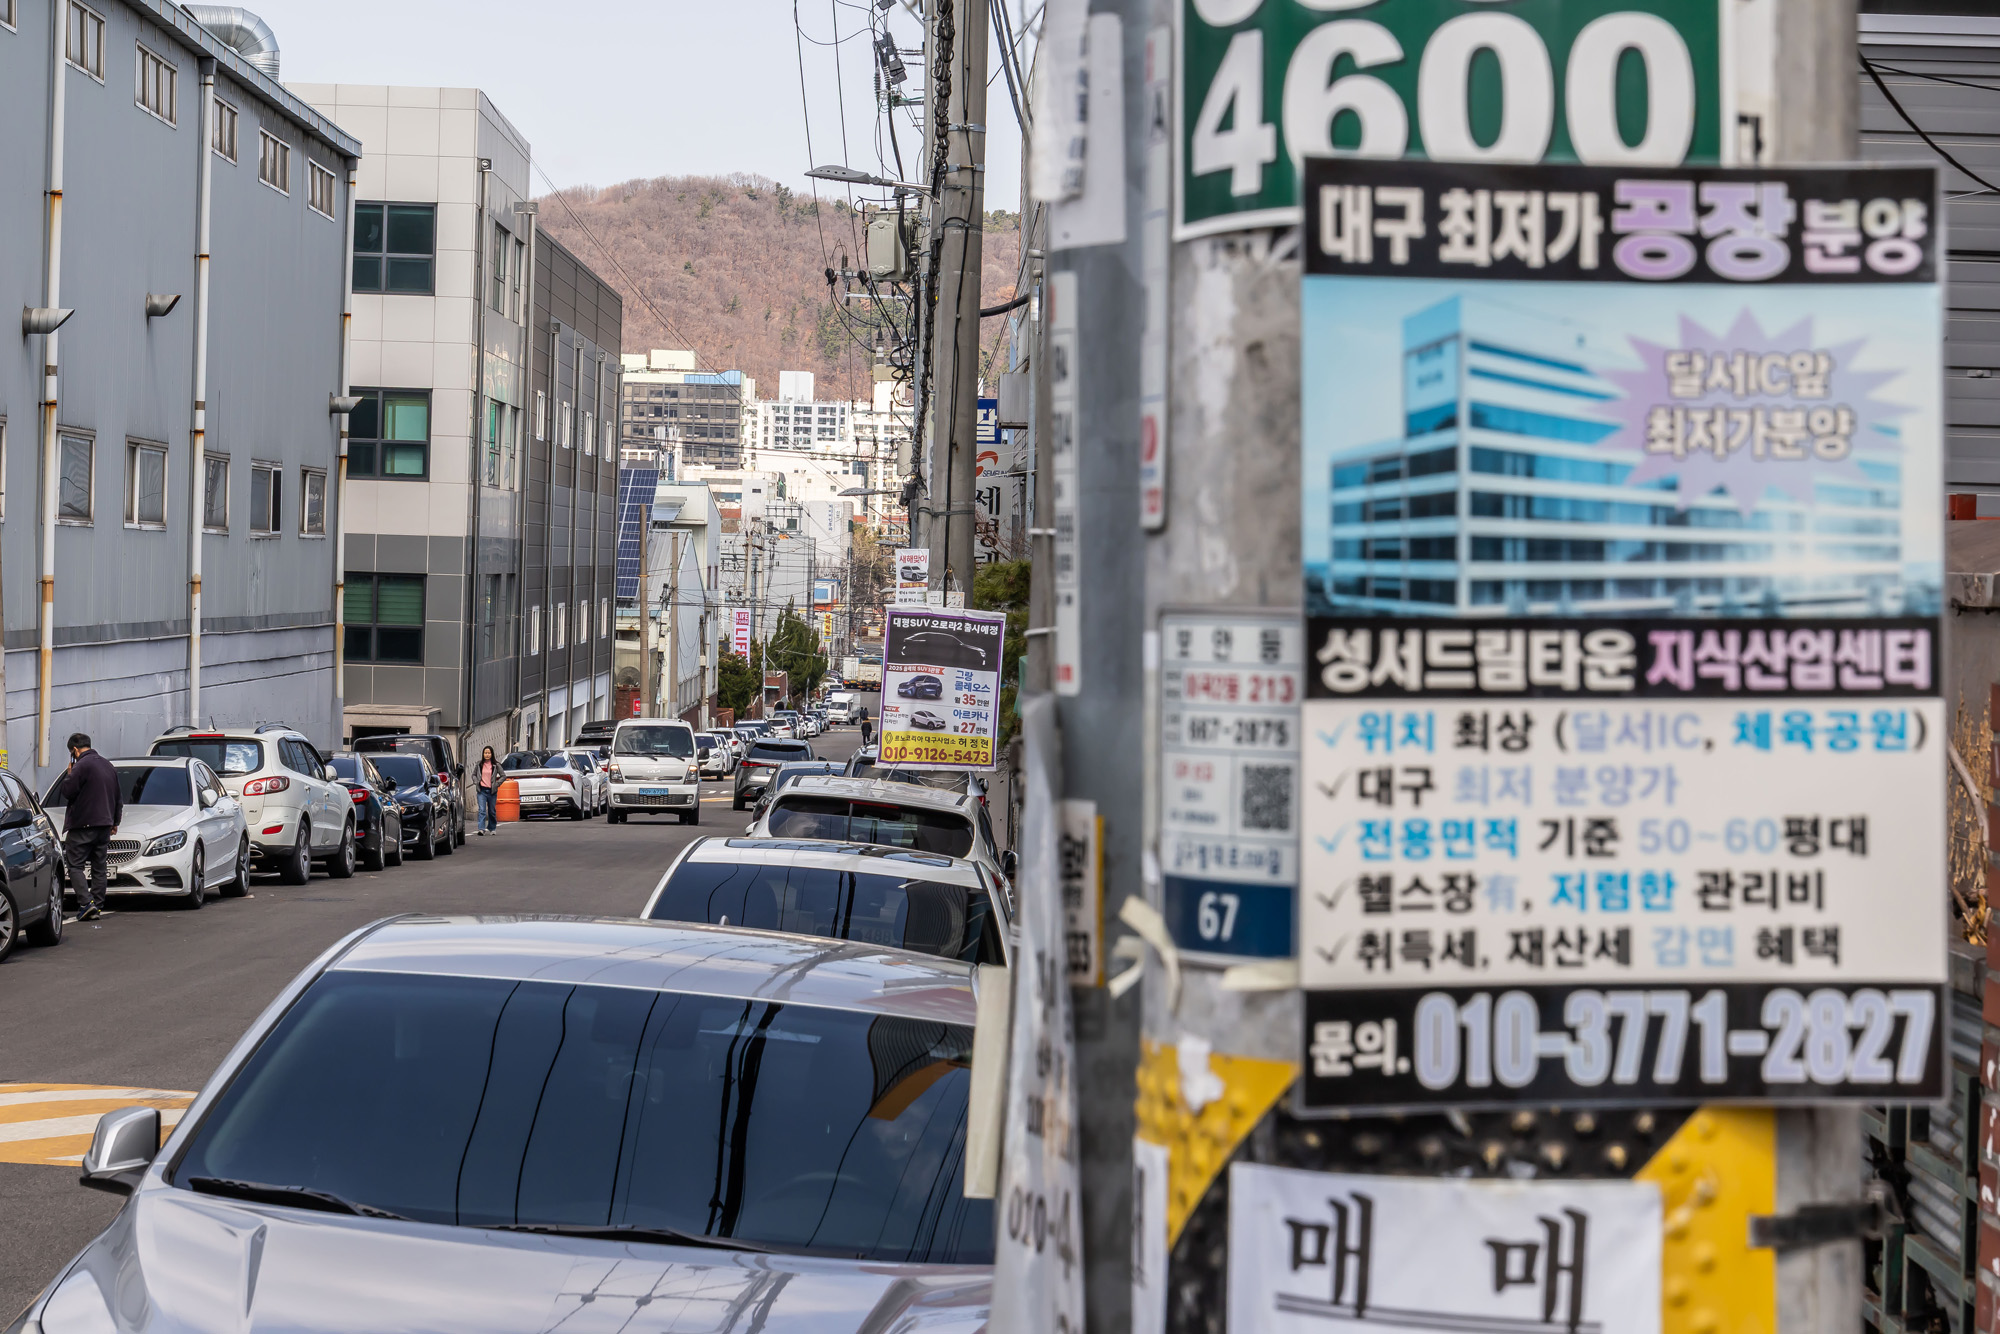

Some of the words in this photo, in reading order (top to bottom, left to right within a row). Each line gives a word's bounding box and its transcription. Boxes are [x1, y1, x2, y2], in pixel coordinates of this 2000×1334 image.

[1319, 184, 1426, 264] 대구
[1440, 189, 1604, 270] 최저가
[1611, 179, 1795, 281] 공장
[1803, 198, 1928, 276] 분양
[1665, 348, 1835, 400] 달서IC앞
[1645, 404, 1857, 461] 최저가분양
[899, 554, 928, 564] 새해맞이
[893, 618, 930, 629] 대형SUV
[931, 620, 963, 632] 오로라2
[963, 622, 999, 636] 출시예정
[955, 669, 974, 681] 그랑
[1316, 628, 1639, 693] 성서드림타운
[1646, 628, 1932, 691] 지식산업센터
[954, 680, 991, 693] 콜레오스
[962, 693, 977, 706] 35
[976, 698, 990, 707] 만원
[952, 708, 989, 721] 아르카나
[960, 722, 976, 734] 27
[975, 726, 988, 735] 만원
[1355, 711, 1437, 754] 위치
[1453, 711, 1536, 753] 최상
[1732, 710, 1929, 754] 체육공원)
[883, 746, 989, 763] 010-9126-5473
[894, 734, 924, 743] 르노코리아
[924, 736, 957, 745] 대구사업소
[1357, 765, 1436, 807] 대구
[1453, 765, 1535, 806] 최저
[1551, 764, 1681, 805] 분양가
[1356, 818, 1520, 861] 전용면적
[1538, 818, 1621, 858] 기준
[1550, 871, 1679, 914] 저렴한
[1695, 870, 1826, 914] 관리비
[1198, 890, 1241, 942] 67
[1356, 928, 1491, 972] 취득세,
[1507, 926, 1634, 969] 재산세
[1651, 925, 1736, 969] 감면
[1754, 925, 1843, 968] 혜택
[1413, 987, 1937, 1091] 010-3771-2827
